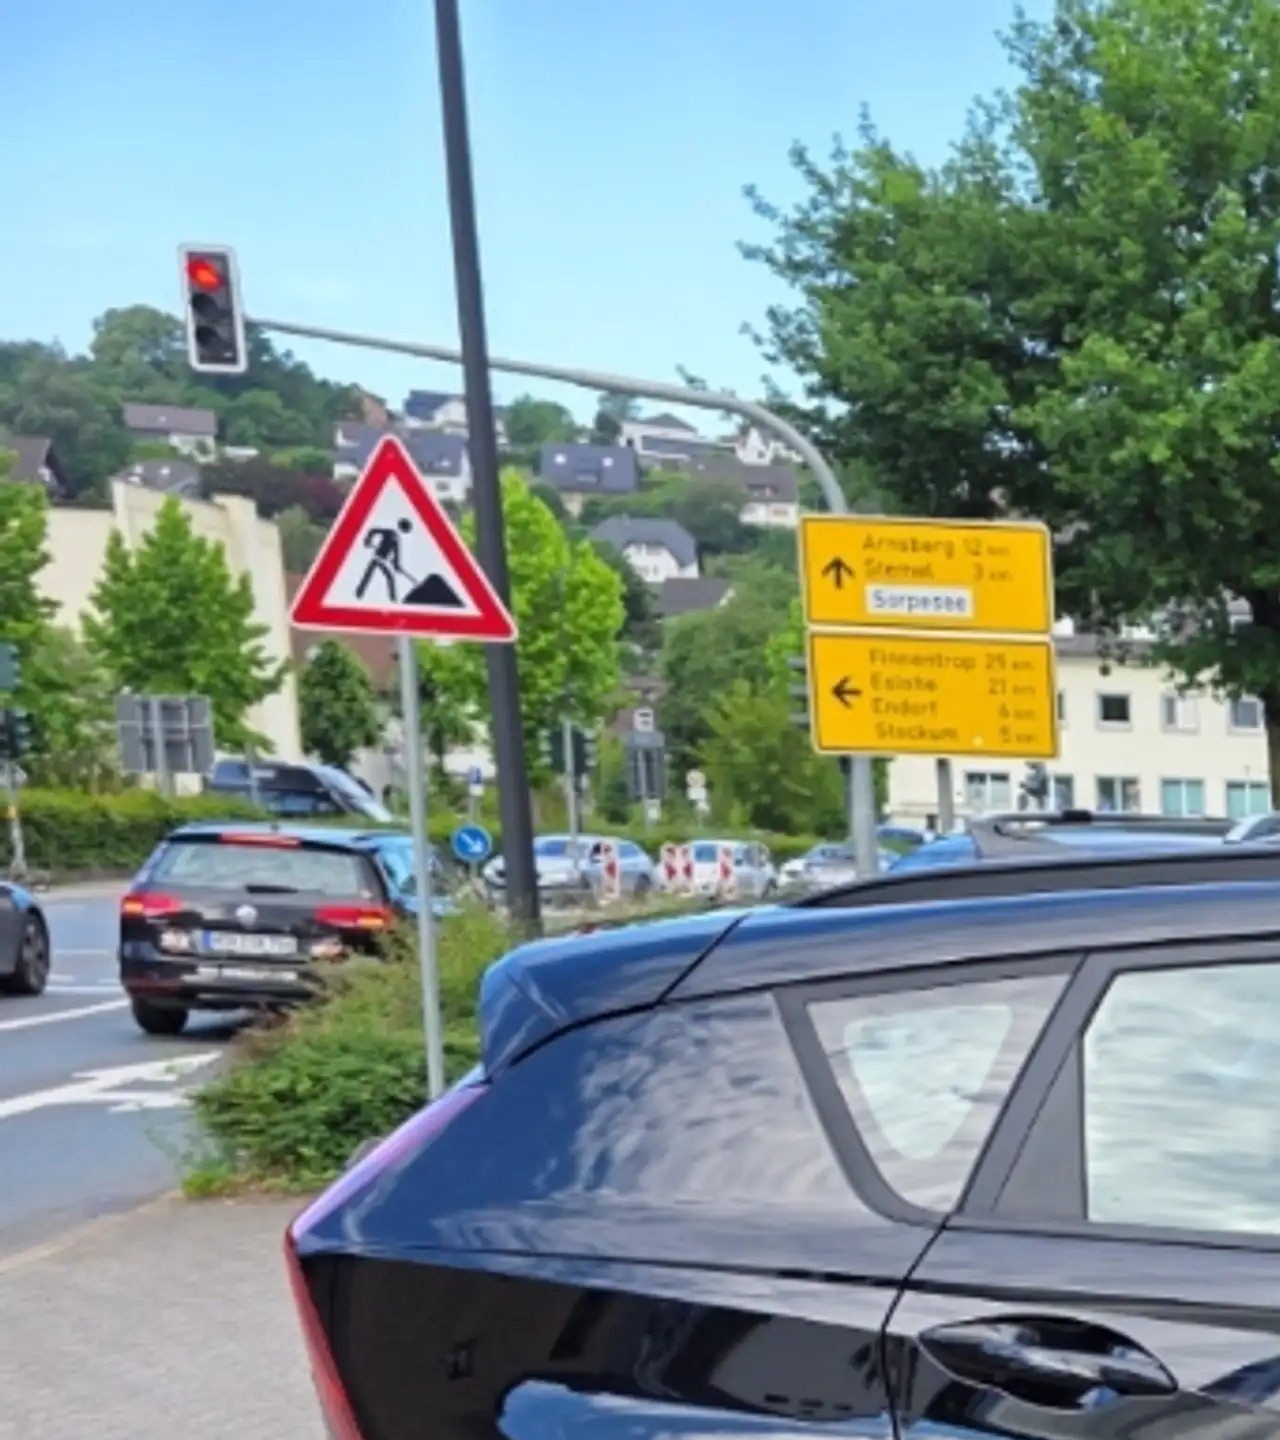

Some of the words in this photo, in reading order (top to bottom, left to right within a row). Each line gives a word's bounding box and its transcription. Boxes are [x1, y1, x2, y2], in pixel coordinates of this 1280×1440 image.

[862, 533, 955, 559] Arnsberg
[872, 589, 967, 613] Sorpesee
[869, 648, 976, 673] Finnentrop
[875, 721, 958, 740] Stockum
